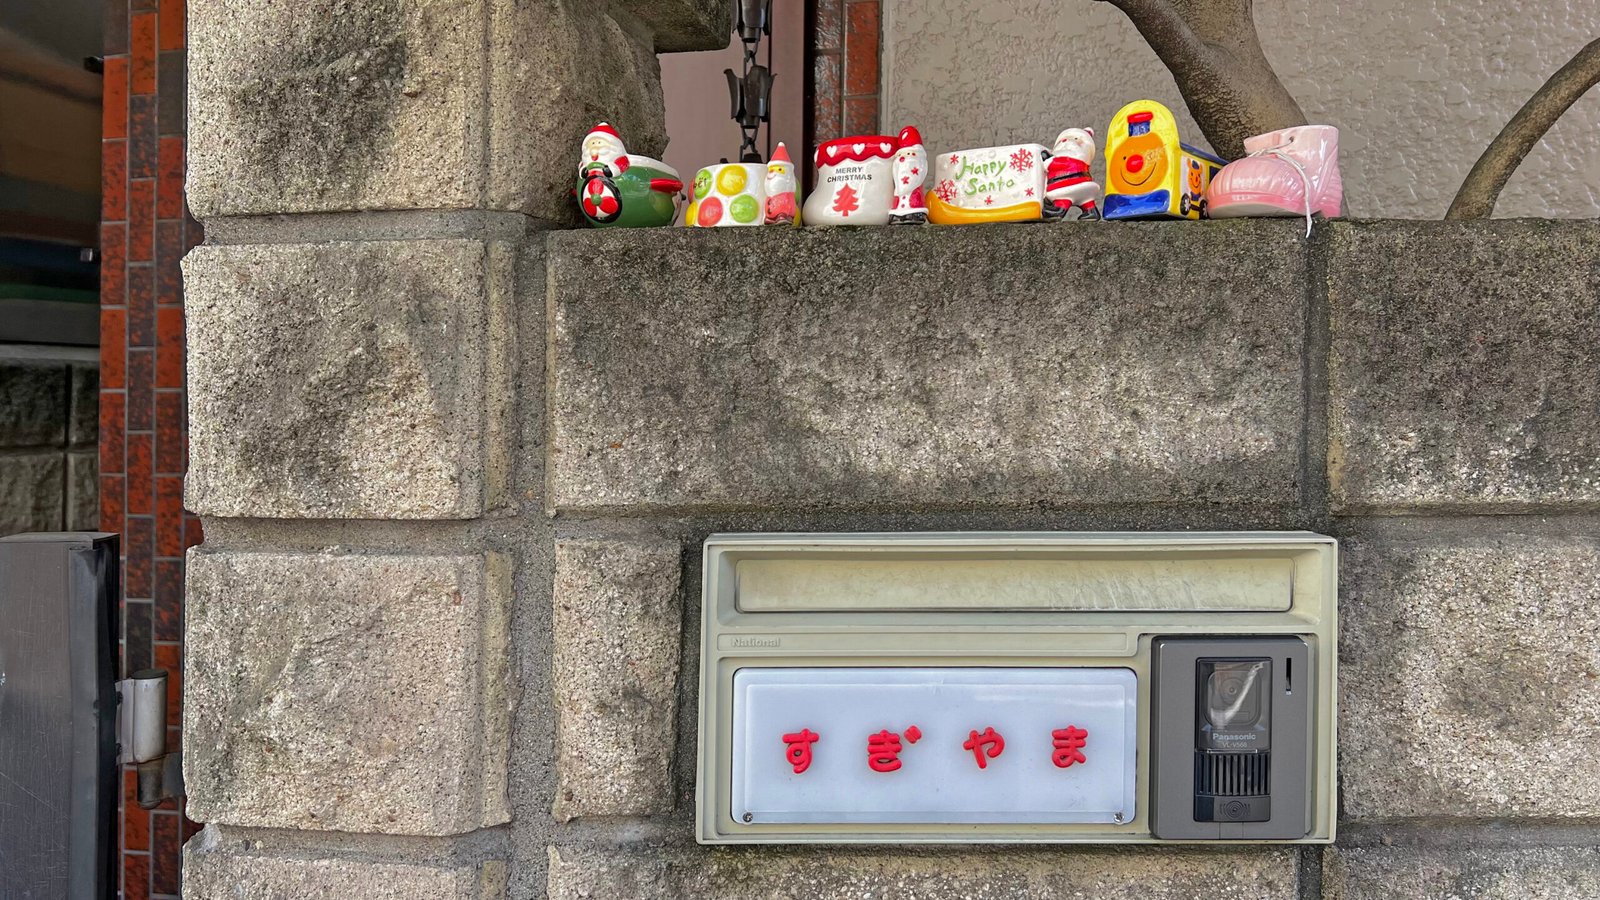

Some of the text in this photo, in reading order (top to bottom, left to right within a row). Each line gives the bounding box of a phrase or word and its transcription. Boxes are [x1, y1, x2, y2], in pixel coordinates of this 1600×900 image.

[835, 166, 863, 174] MERRY
[955, 156, 1007, 180] Happy
[827, 174, 872, 183] CHRISTMAS
[731, 637, 781, 648] National
[1212, 732, 1256, 740] Panasonic
[782, 725, 1089, 774] すぎやま
